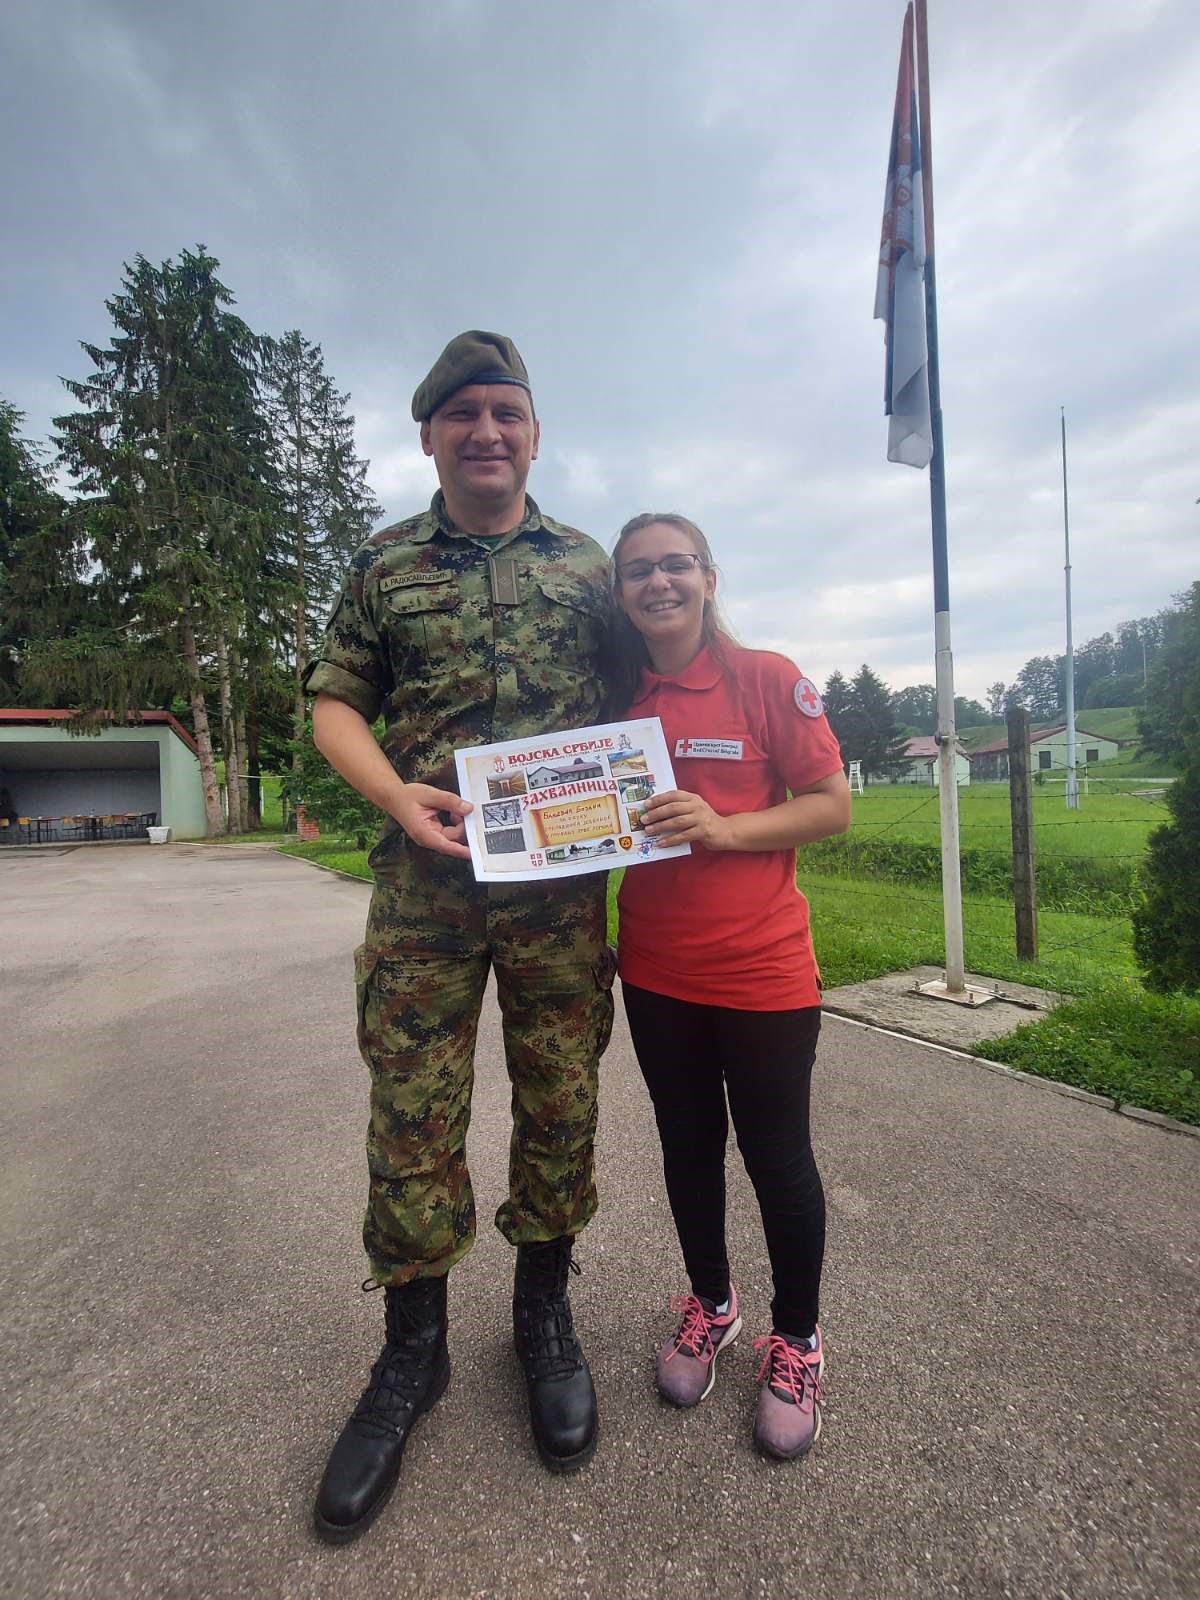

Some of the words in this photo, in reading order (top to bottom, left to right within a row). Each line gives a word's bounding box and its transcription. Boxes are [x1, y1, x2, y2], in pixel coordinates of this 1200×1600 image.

[508, 747, 560, 765] ВОЈСКА
[563, 738, 613, 754] СРБИЈЕ
[521, 780, 617, 810] ЗАХВАЛНИЦА
